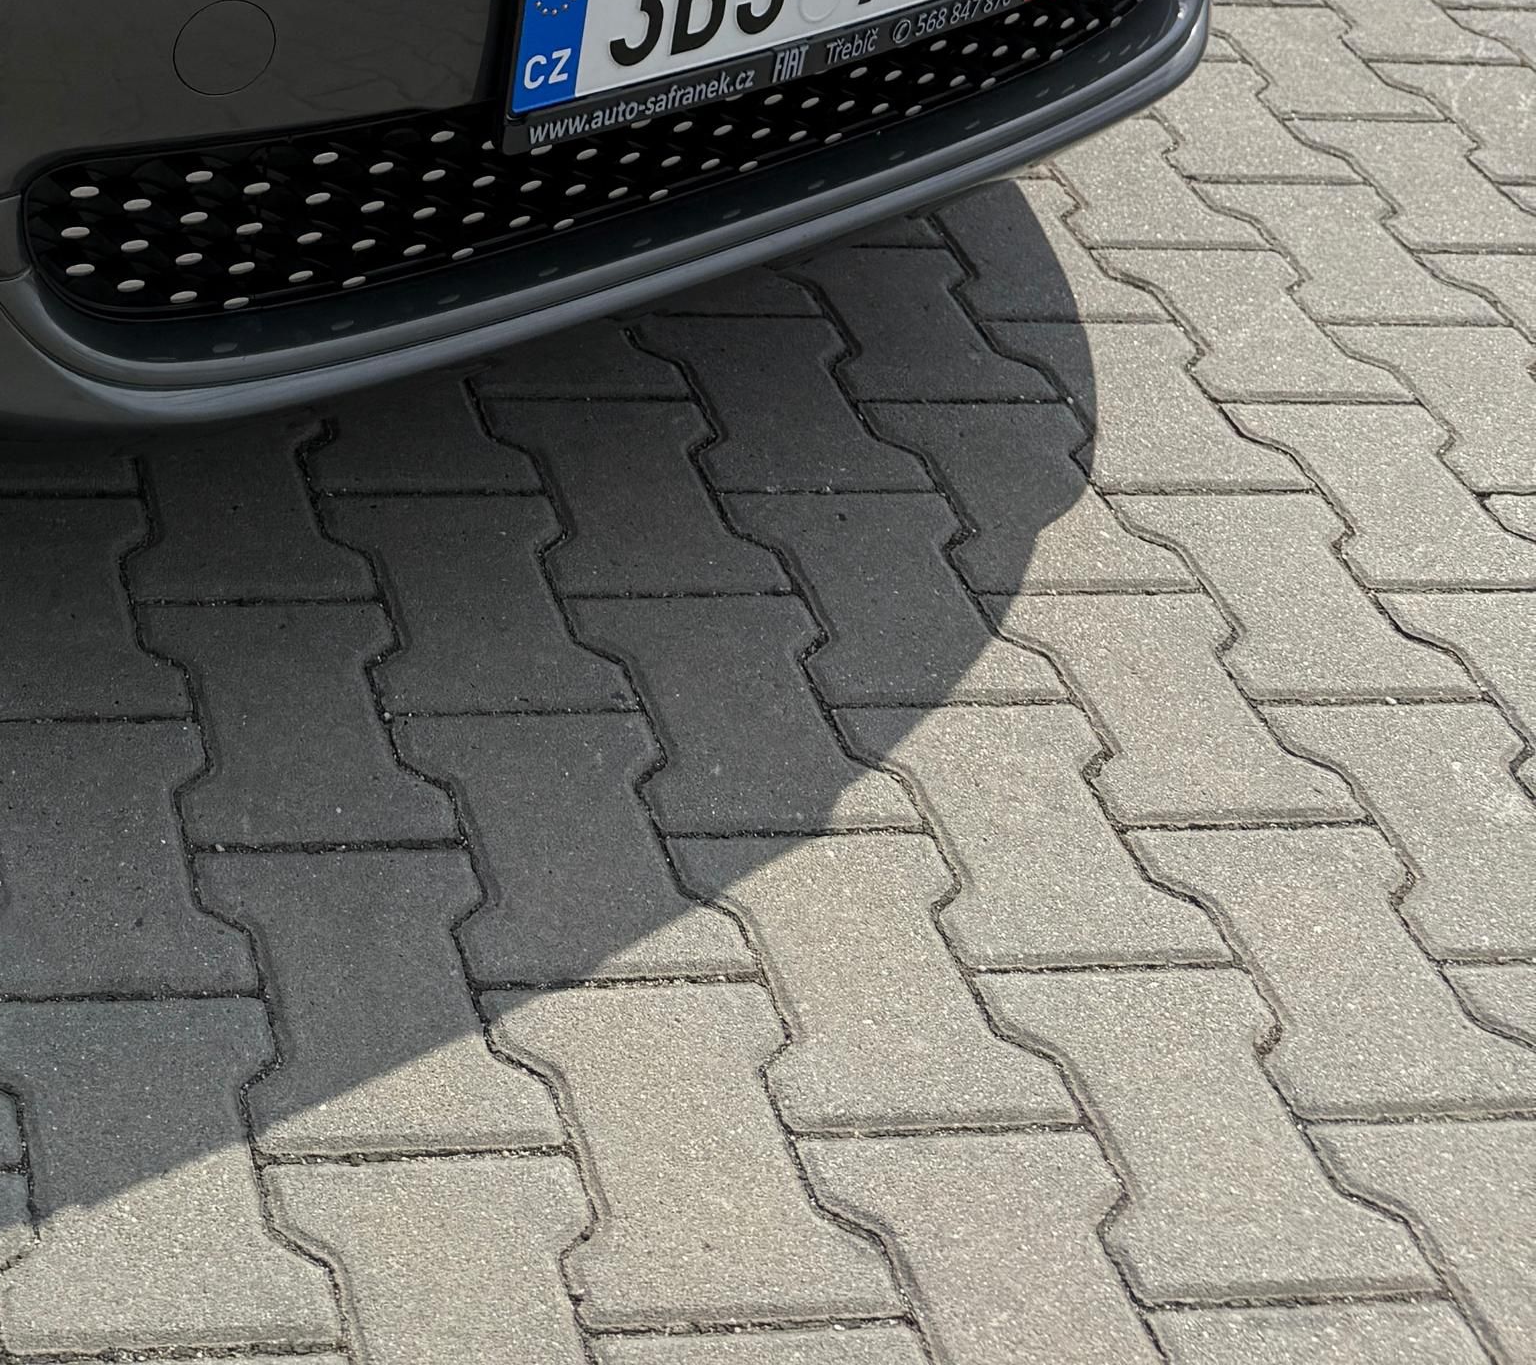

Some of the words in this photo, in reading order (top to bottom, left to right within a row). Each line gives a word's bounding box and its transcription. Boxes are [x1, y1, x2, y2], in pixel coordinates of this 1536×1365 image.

[523, 48, 572, 89] CZ
[529, 70, 755, 145] www.auto-safranek.cz
[772, 45, 809, 83] FIAT
[826, 28, 879, 65] Třebíč
[915, 8, 947, 37] 568
